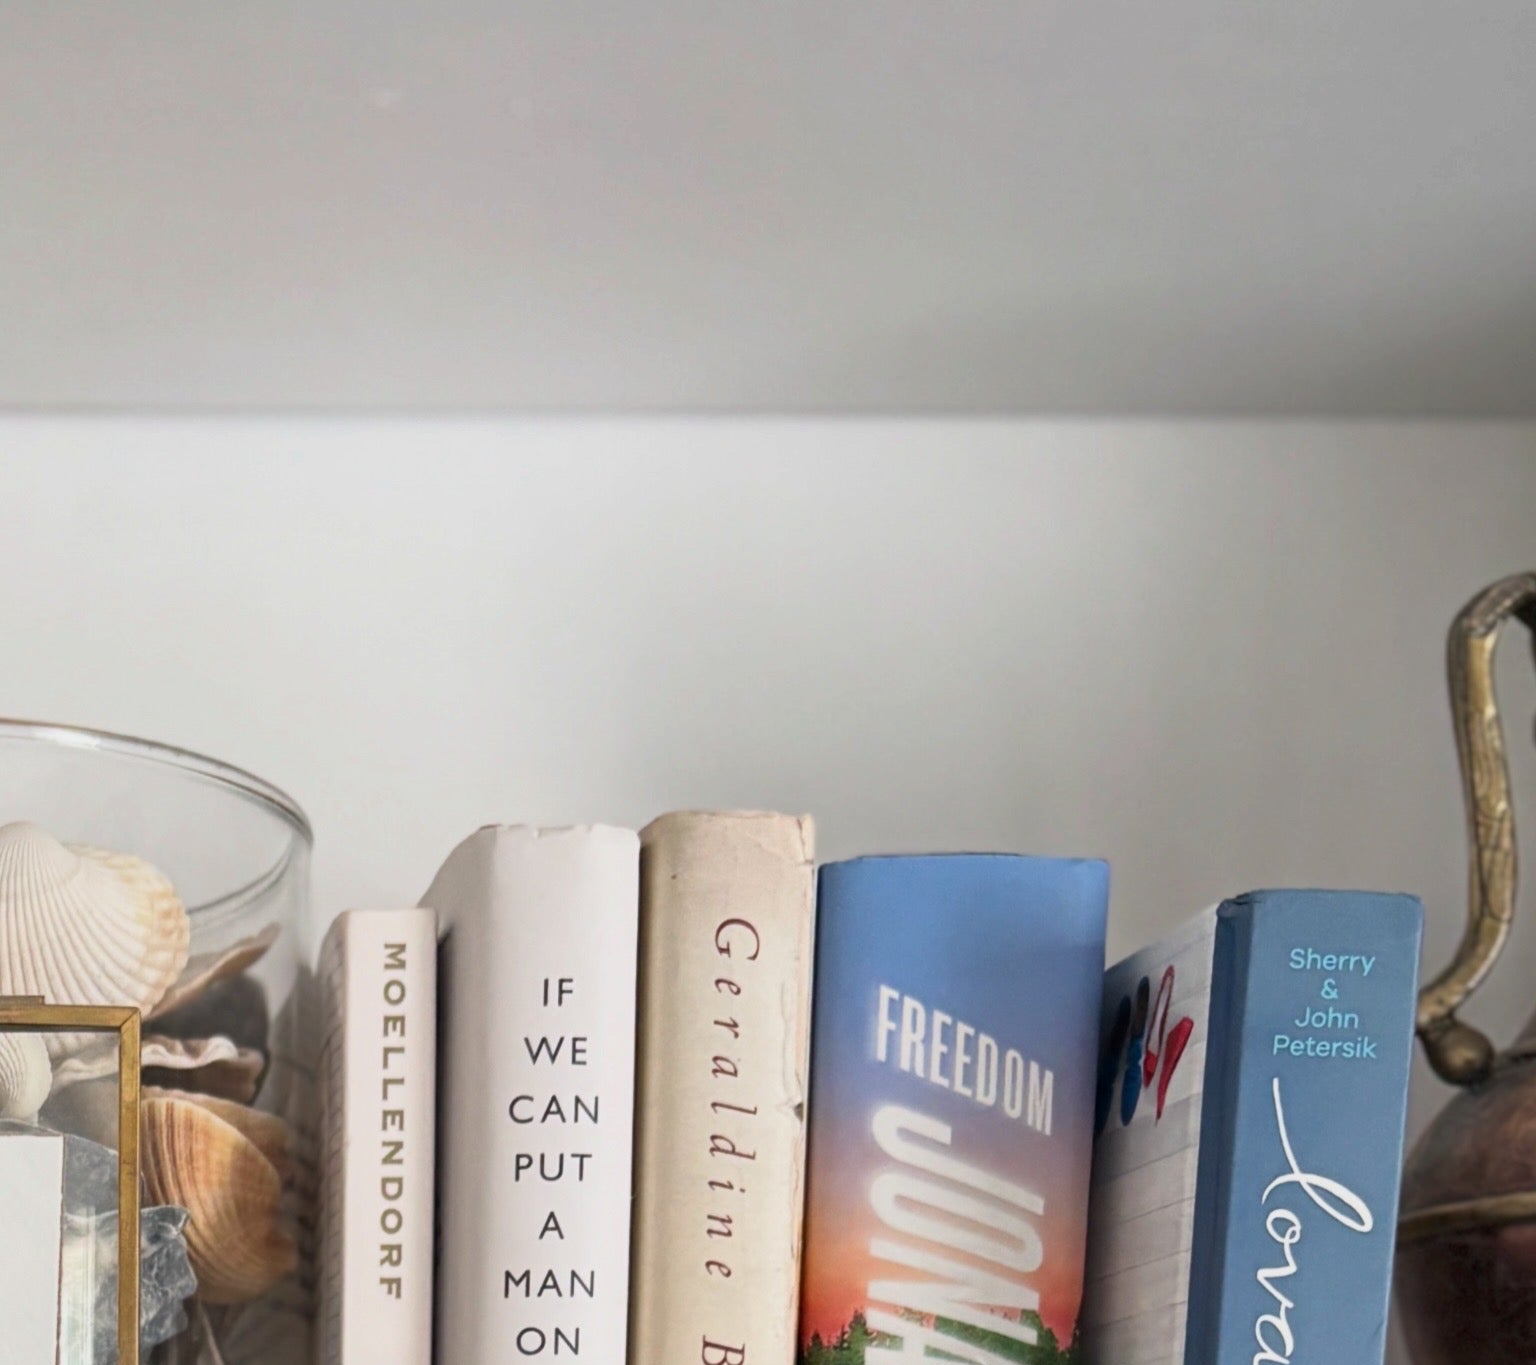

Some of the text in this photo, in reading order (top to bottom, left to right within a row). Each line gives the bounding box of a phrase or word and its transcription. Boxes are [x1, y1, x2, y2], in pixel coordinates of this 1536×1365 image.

[1289, 947, 1376, 977] Sherry
[542, 977, 575, 1008] IF
[1320, 978, 1339, 999] &
[1294, 1006, 1359, 1029] John
[523, 1035, 589, 1066] WE
[875, 983, 1054, 1136] FREEDOM
[1272, 1034, 1378, 1059] Petersik
[508, 1094, 600, 1125] CAN
[704, 917, 761, 1279] Geraldine
[378, 941, 408, 1299] MOELLENDORF
[514, 1152, 593, 1183] PUT
[538, 1210, 565, 1241] A
[503, 1269, 596, 1299] MAN
[515, 1325, 582, 1356] ON
